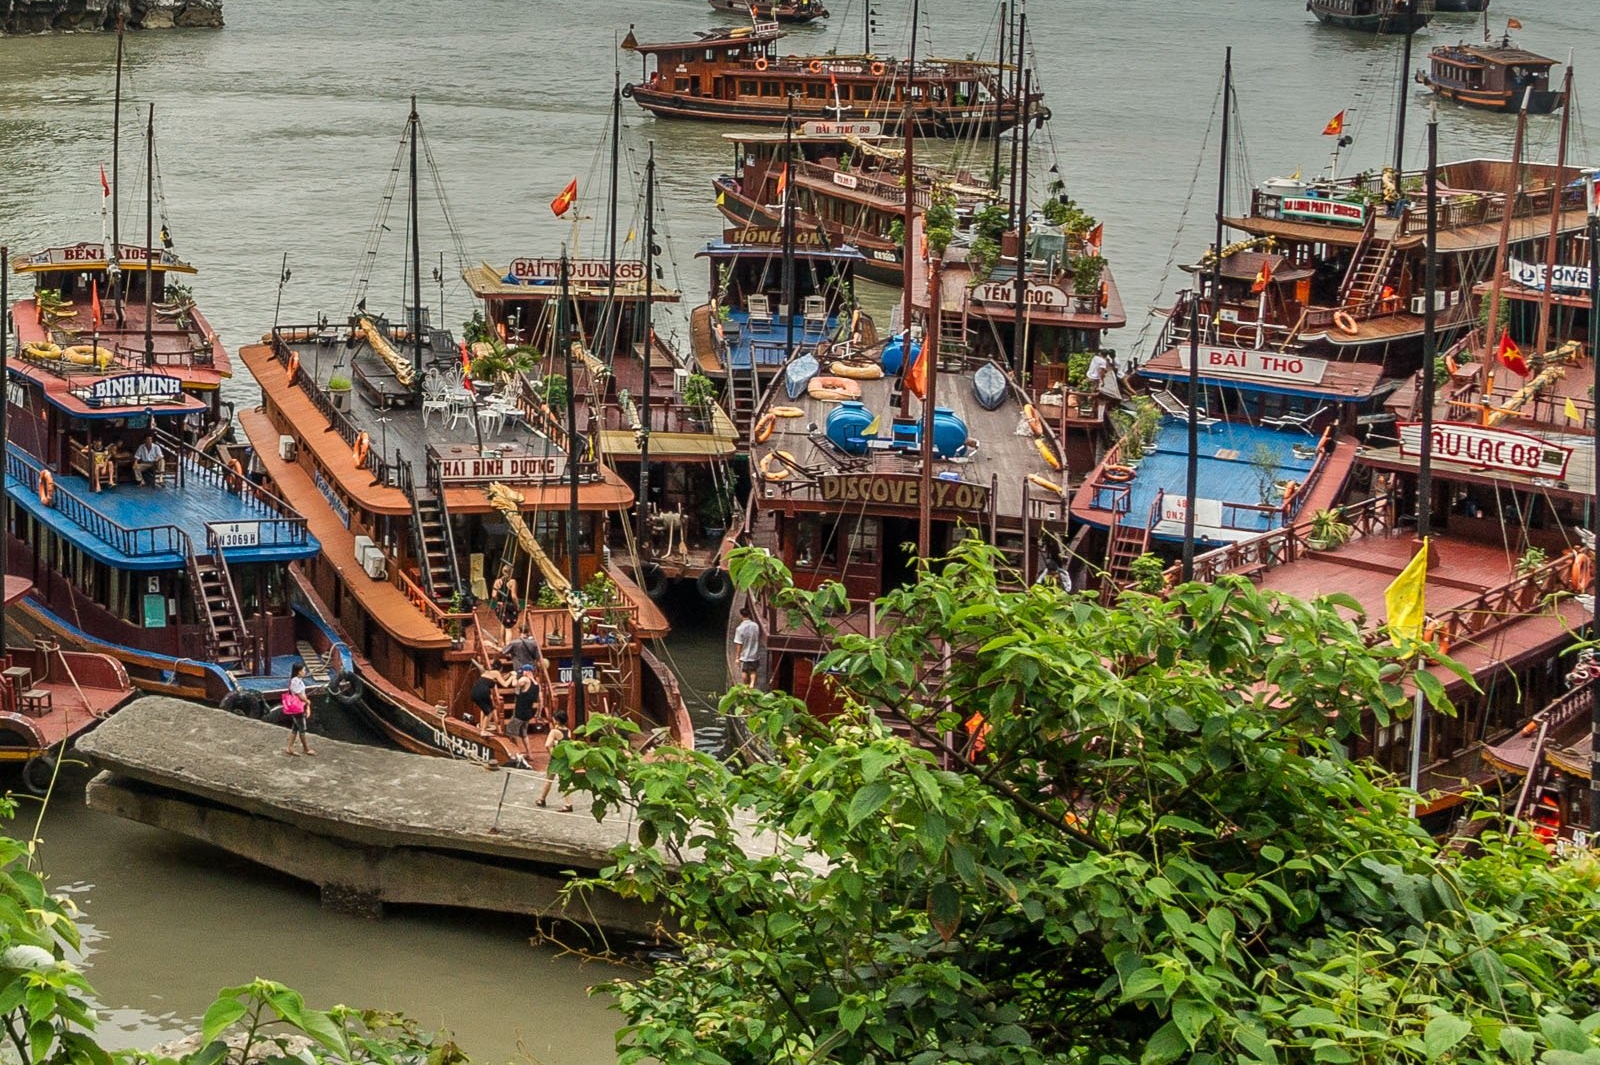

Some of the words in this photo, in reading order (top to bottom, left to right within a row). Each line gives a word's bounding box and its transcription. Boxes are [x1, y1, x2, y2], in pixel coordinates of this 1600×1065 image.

[620, 263, 643, 278] 65
[1209, 350, 1247, 367] BÀI
[95, 377, 135, 397] BÌNH
[138, 376, 180, 394] MINH
[1511, 444, 1540, 468] 08
[227, 535, 248, 545] 3069
[250, 534, 256, 544] H
[150, 577, 158, 592] 5
[483, 746, 490, 763] H
